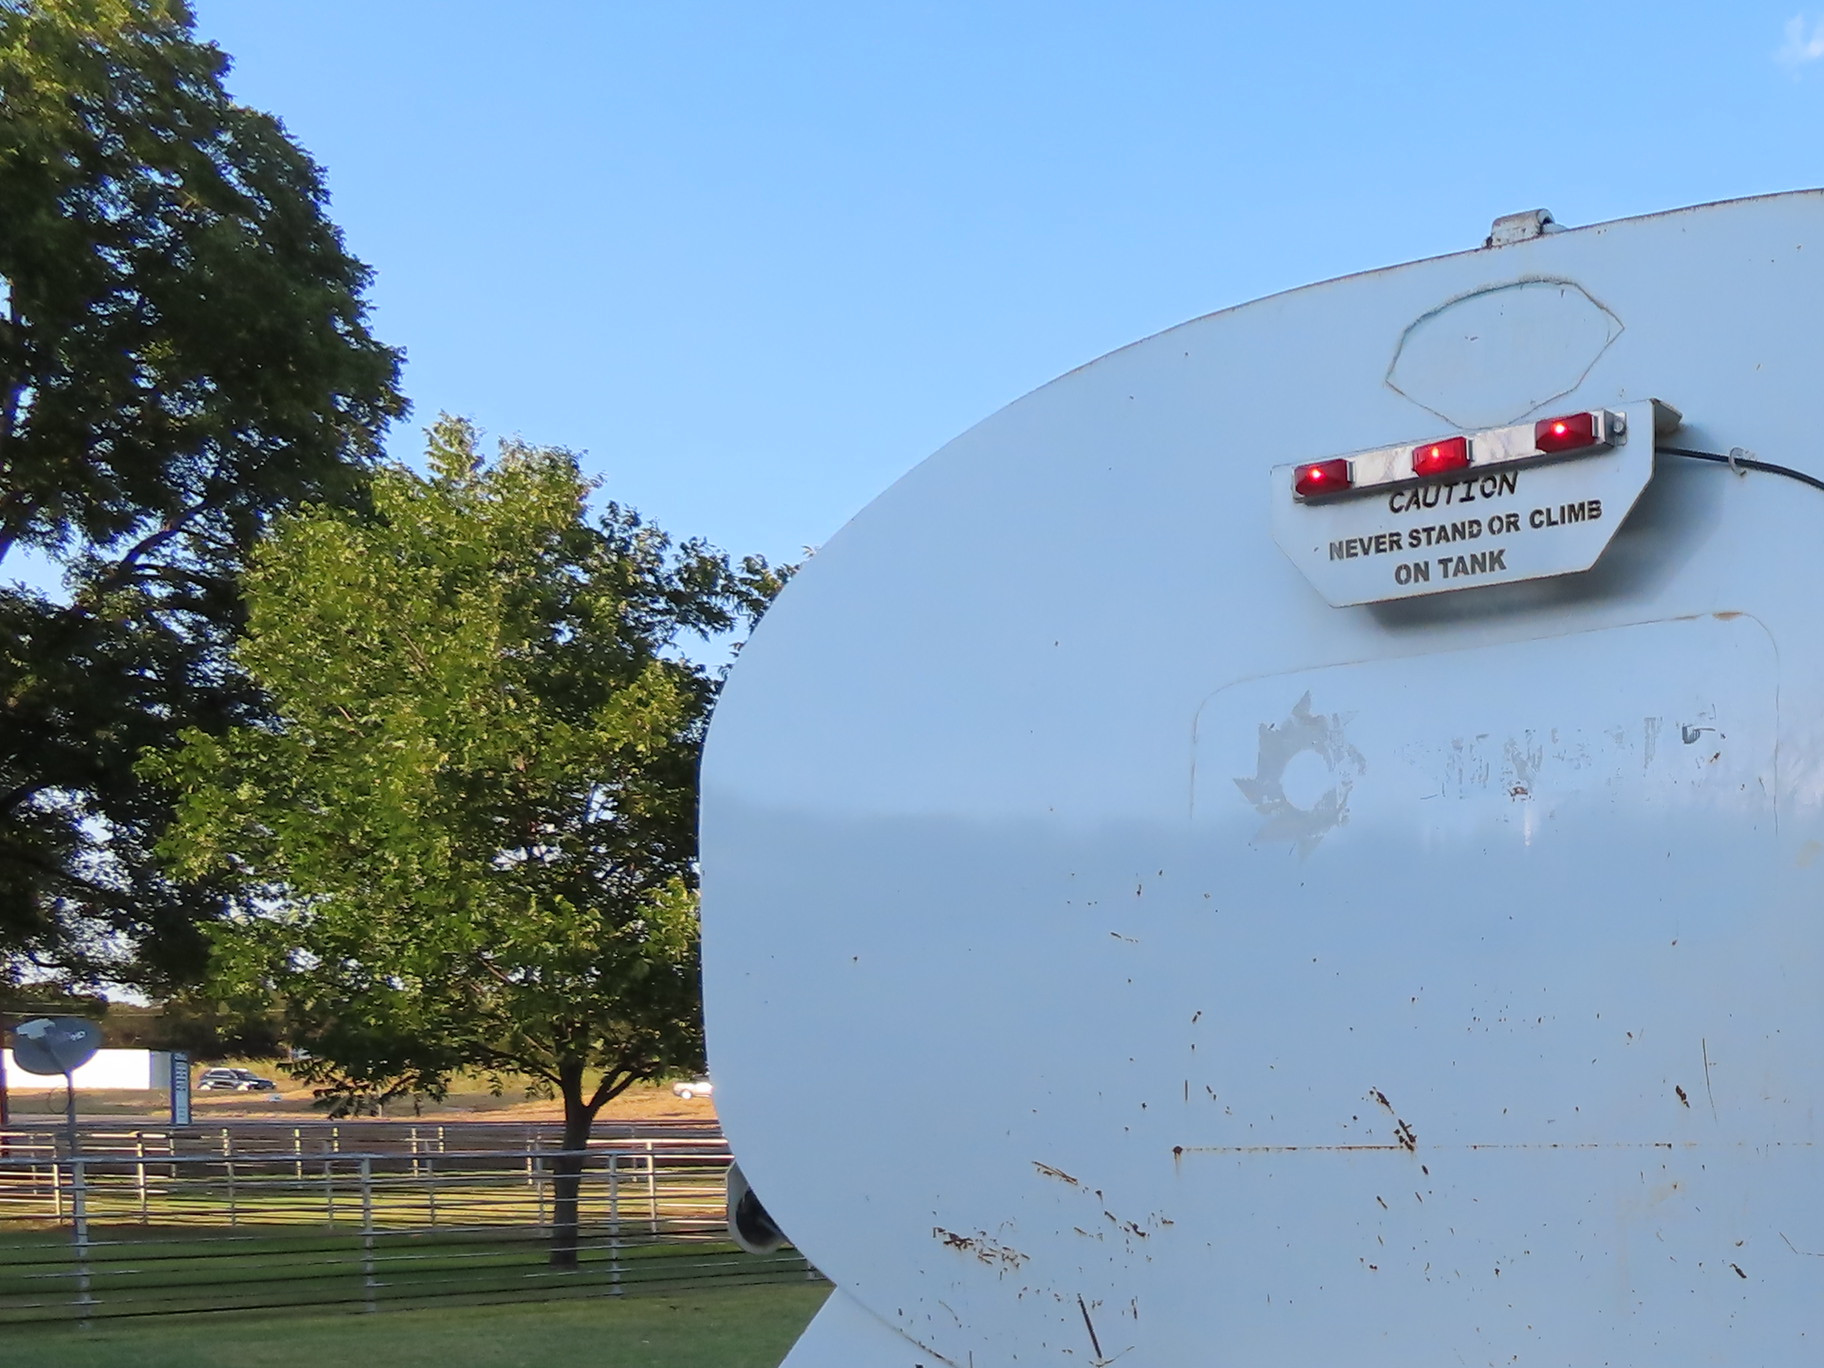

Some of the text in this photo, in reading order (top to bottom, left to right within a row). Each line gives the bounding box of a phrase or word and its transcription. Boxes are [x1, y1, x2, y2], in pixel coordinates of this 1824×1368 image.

[1389, 471, 1519, 513] CAUTION
[1329, 499, 1602, 561] NEVER STAND OR CLIMB
[1394, 548, 1507, 585] ON TANK
